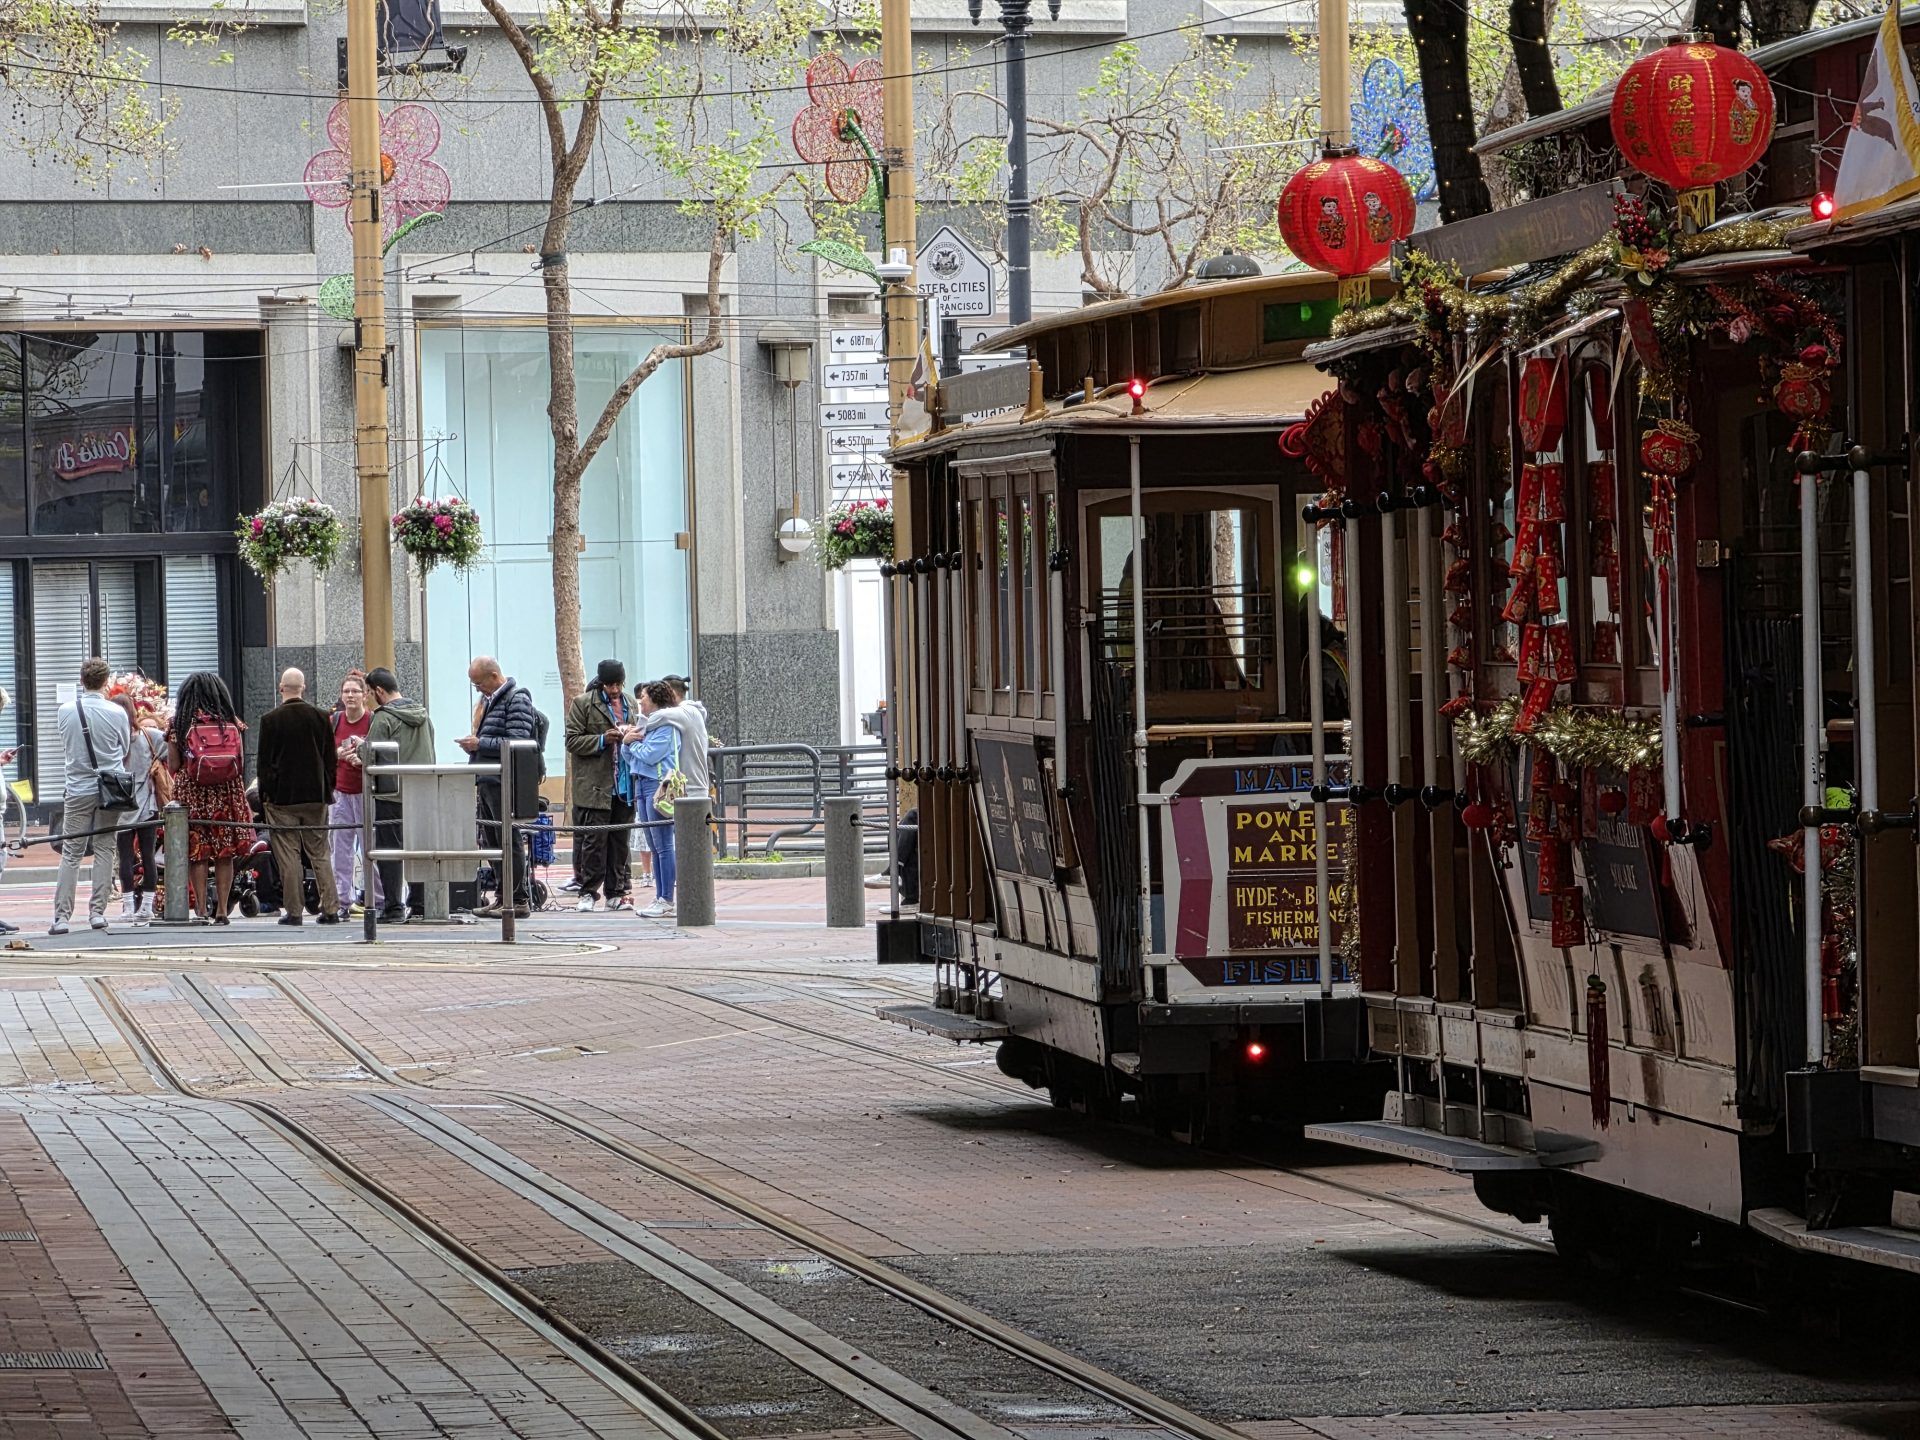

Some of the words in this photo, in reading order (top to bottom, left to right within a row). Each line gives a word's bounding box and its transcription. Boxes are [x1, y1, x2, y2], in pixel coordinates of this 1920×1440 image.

[919, 284, 947, 293] STER
[951, 282, 986, 293] CITIES
[940, 302, 983, 311] RANCISCO
[1234, 765, 1349, 792] MARK
[1234, 843, 1345, 863] MARKE
[1236, 886, 1278, 907] HYDE
[1282, 887, 1302, 906] AND
[1305, 884, 1357, 906] BAC
[1223, 958, 1351, 985] FISHE
